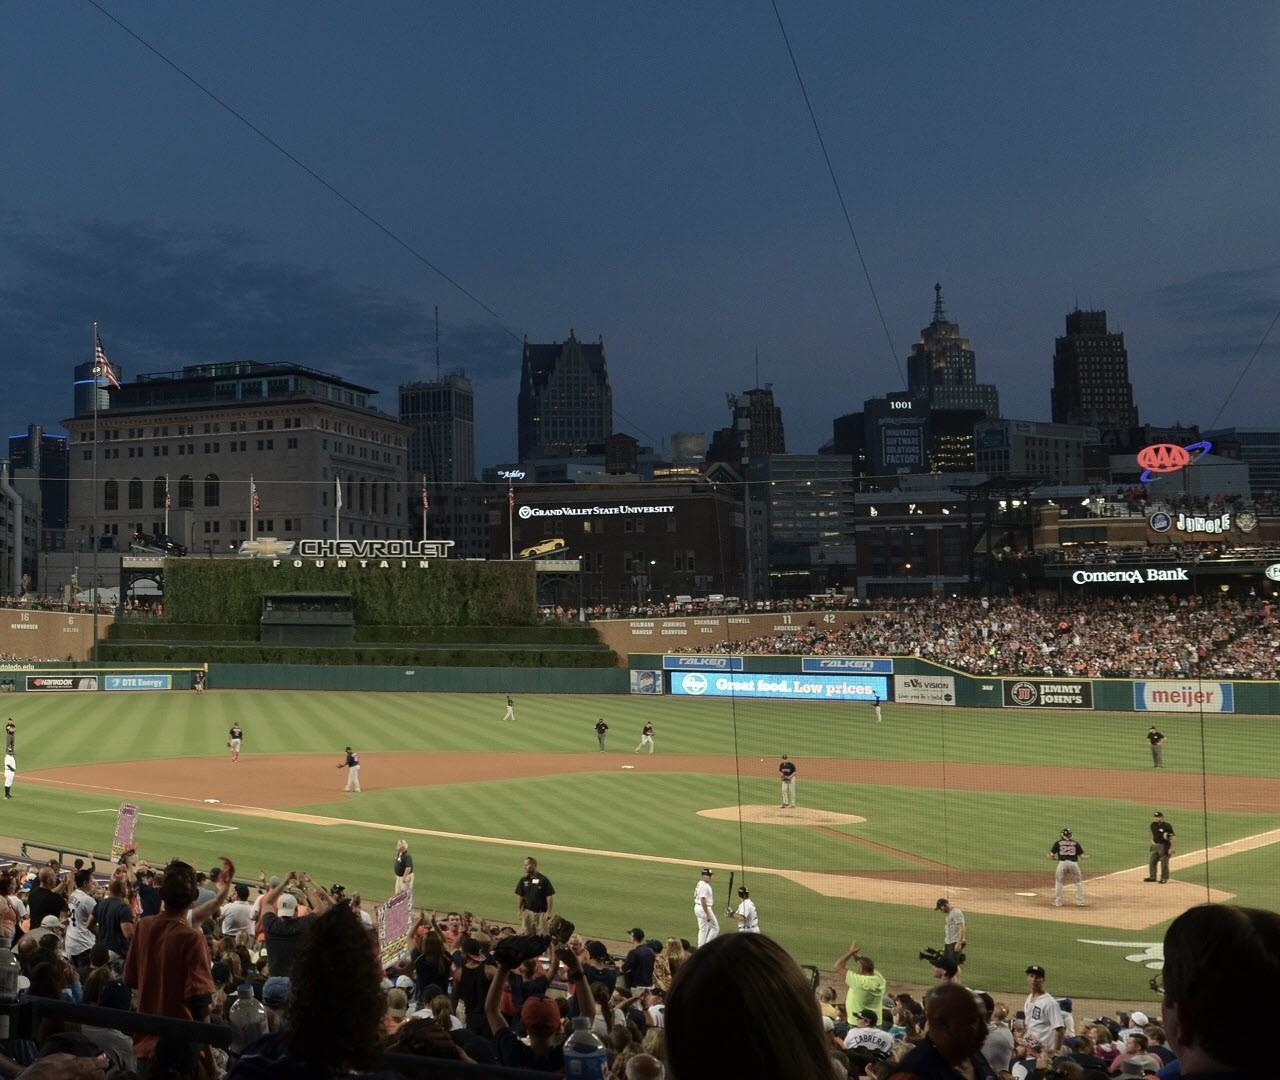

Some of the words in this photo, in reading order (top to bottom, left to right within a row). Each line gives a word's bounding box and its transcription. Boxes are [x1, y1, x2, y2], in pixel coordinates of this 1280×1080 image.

[890, 401, 912, 409] 1001
[886, 454, 919, 464] FACTORY
[1144, 447, 1184, 468] AAA
[504, 470, 526, 480] Ashley
[593, 506, 619, 515] STATE
[619, 505, 674, 514] UNIVERSITY
[1176, 513, 1231, 533] JUNGLE
[300, 540, 455, 558] CHEVROLET
[273, 560, 429, 568] FOUNTAIN
[1147, 567, 1190, 582] Bank
[20, 612, 30, 622] 16
[68, 616, 74, 625] 6
[782, 615, 792, 625] 11
[823, 614, 836, 624] 42
[678, 657, 727, 667] FALKEN
[819, 659, 874, 670] FALKEN
[122, 679, 137, 687] DTE
[138, 679, 163, 688] Energy
[716, 680, 756, 692] Great
[757, 681, 792, 693] food.
[793, 681, 822, 694] Low
[1039, 685, 1082, 694] JIMMY
[1040, 695, 1083, 705] JOHN'S
[1152, 686, 1214, 707] meijer
[854, 1034, 886, 1048] CABRERA
